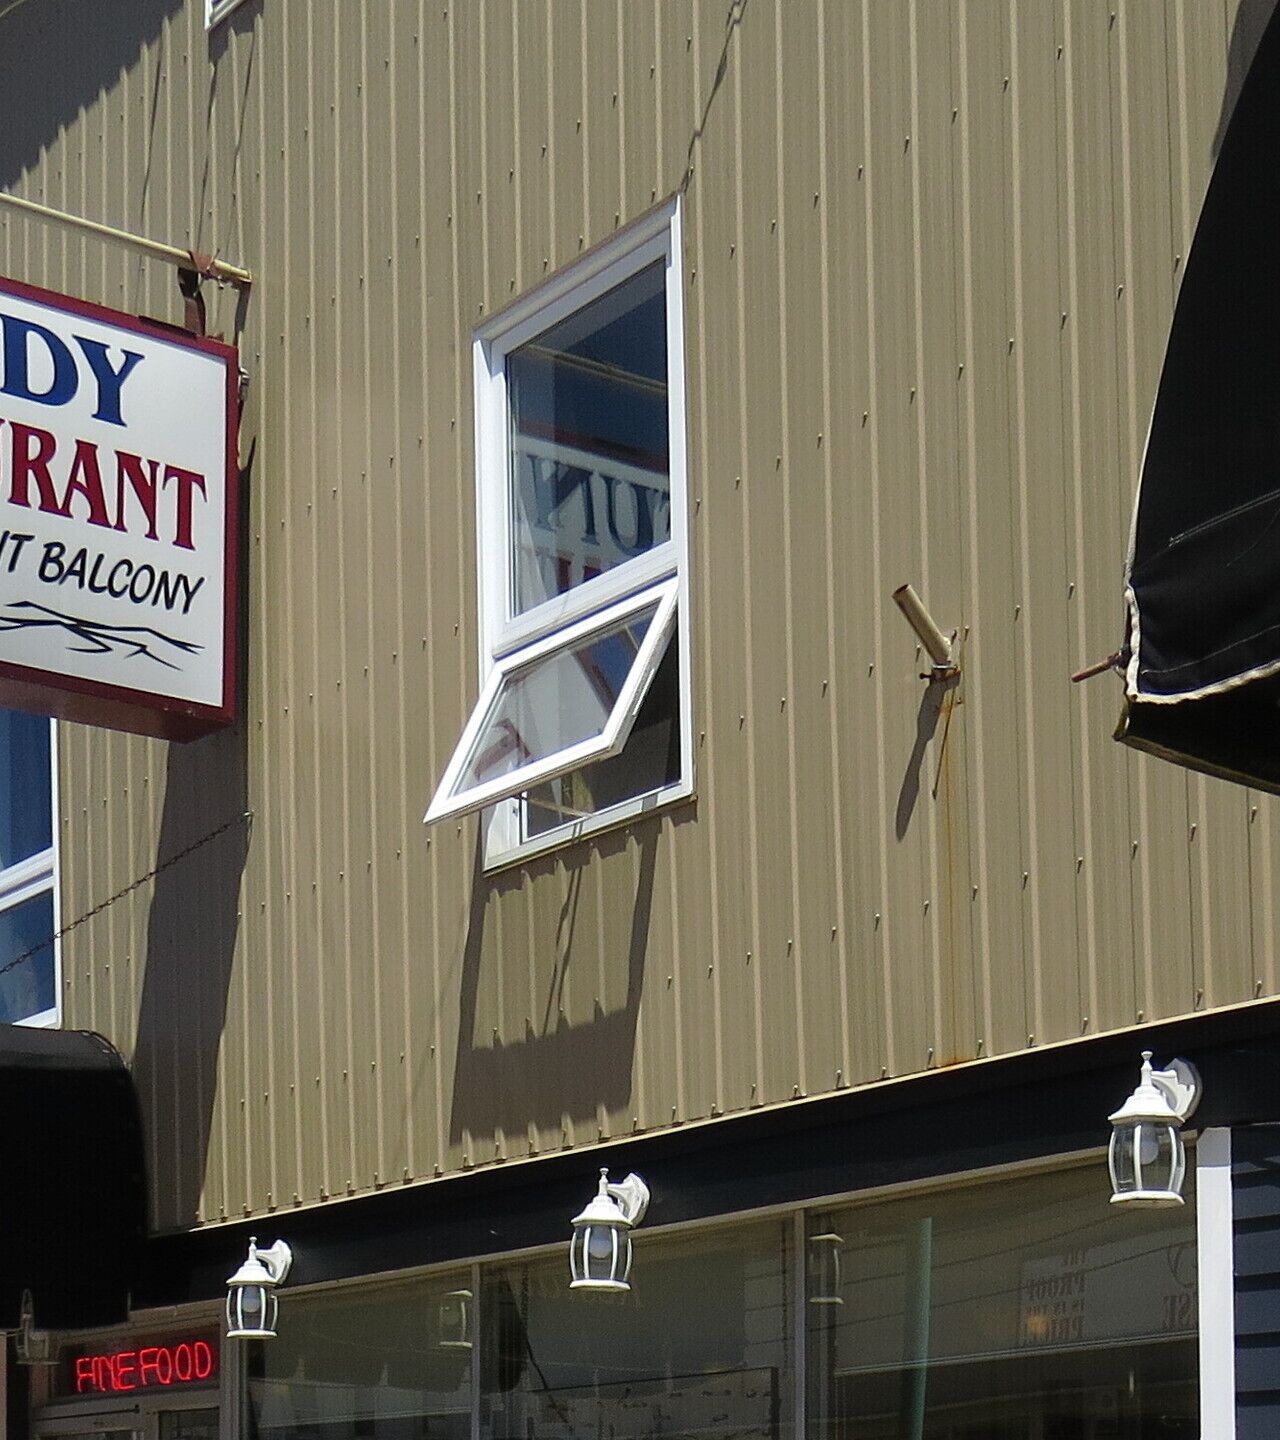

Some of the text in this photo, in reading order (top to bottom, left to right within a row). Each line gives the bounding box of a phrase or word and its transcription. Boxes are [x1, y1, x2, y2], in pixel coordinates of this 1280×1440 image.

[38, 542, 204, 614] BALCONY
[76, 1342, 212, 1392] FINE FOOD
